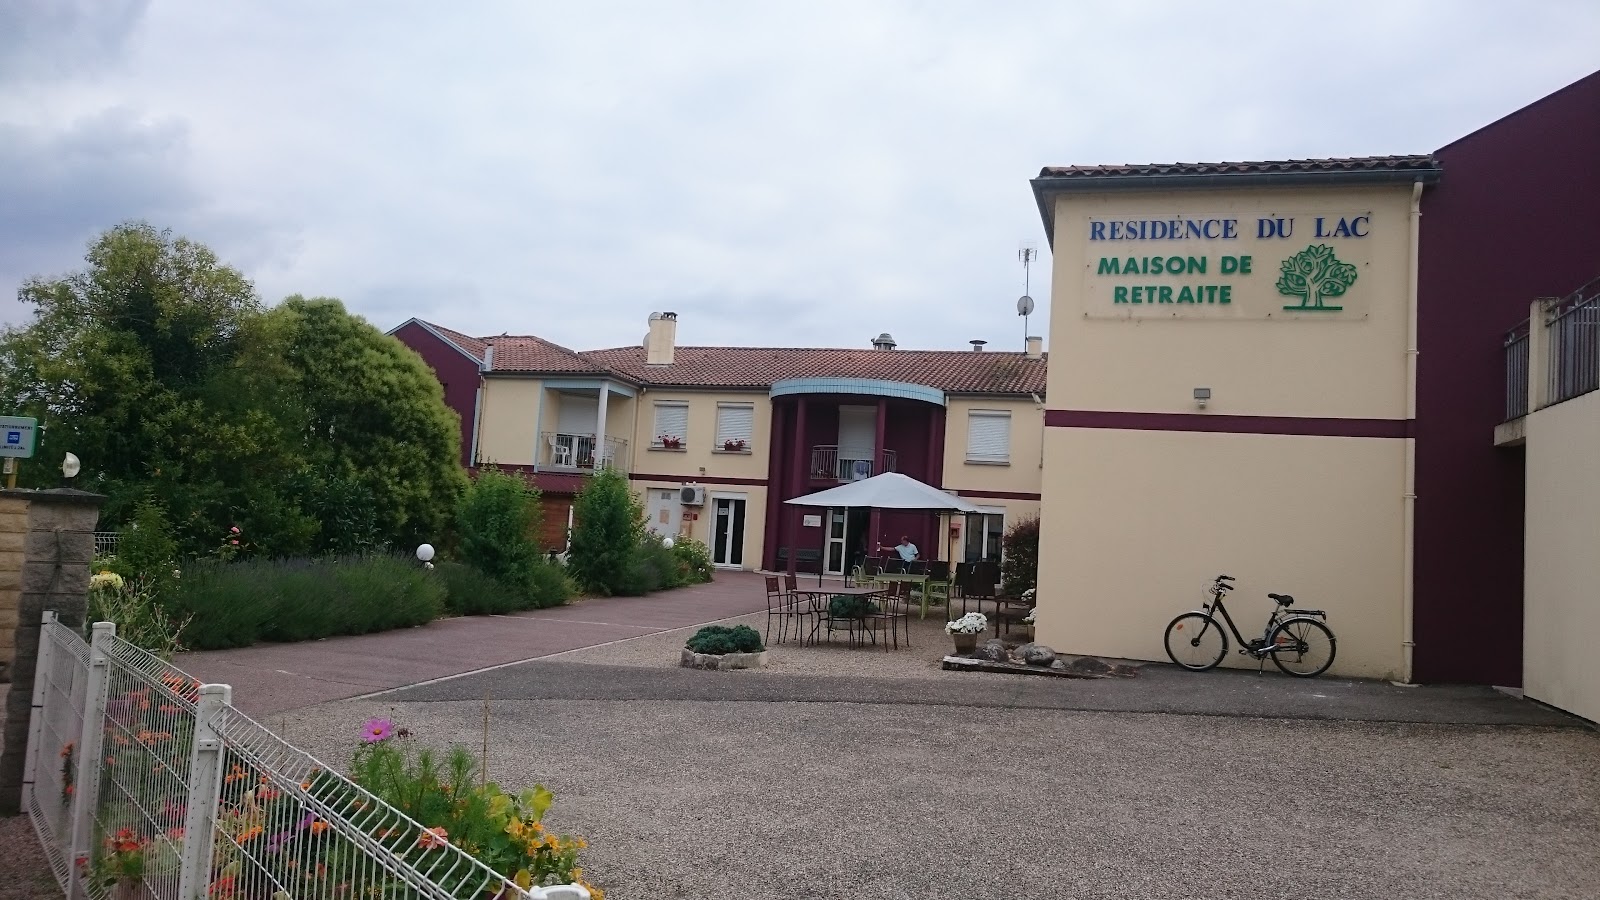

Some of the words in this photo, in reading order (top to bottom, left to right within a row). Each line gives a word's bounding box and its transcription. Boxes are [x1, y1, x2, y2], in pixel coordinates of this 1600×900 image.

[1256, 218, 1294, 238] DU
[1314, 216, 1370, 238] LAC
[1098, 256, 1207, 275] MAISON
[1221, 255, 1252, 274] DE
[1114, 285, 1231, 304] RETRAITE
